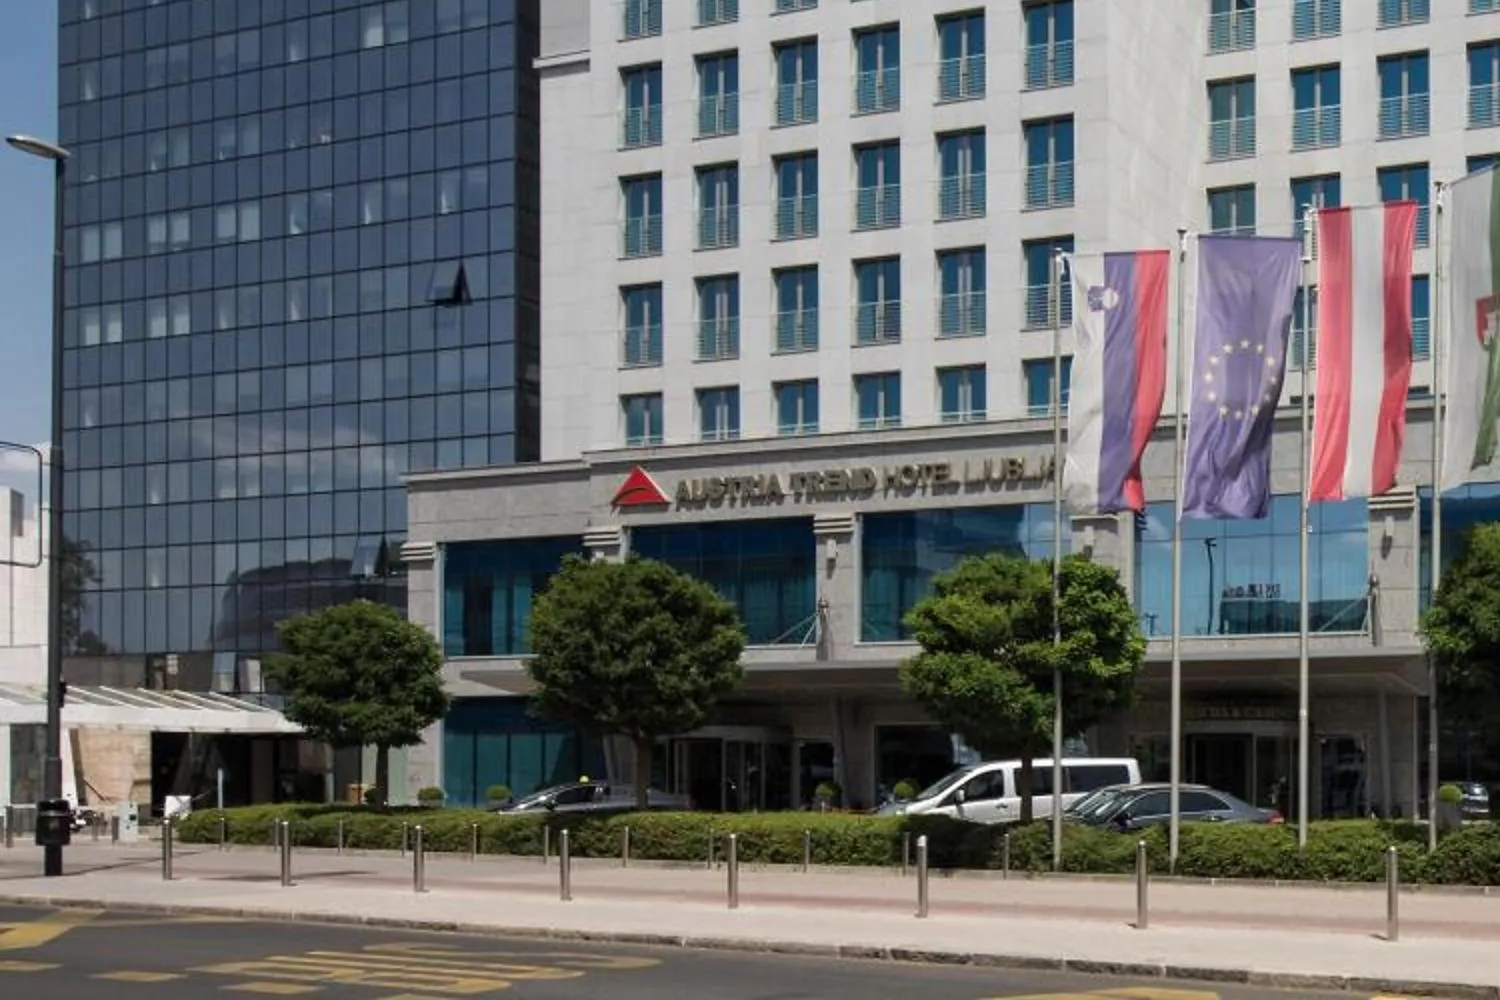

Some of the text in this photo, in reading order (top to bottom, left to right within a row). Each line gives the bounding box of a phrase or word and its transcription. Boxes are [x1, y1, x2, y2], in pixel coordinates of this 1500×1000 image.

[676, 454, 1062, 504] AUSTRIA TREND HOTEL LJUBLJA
[184, 941, 664, 995] BUS
